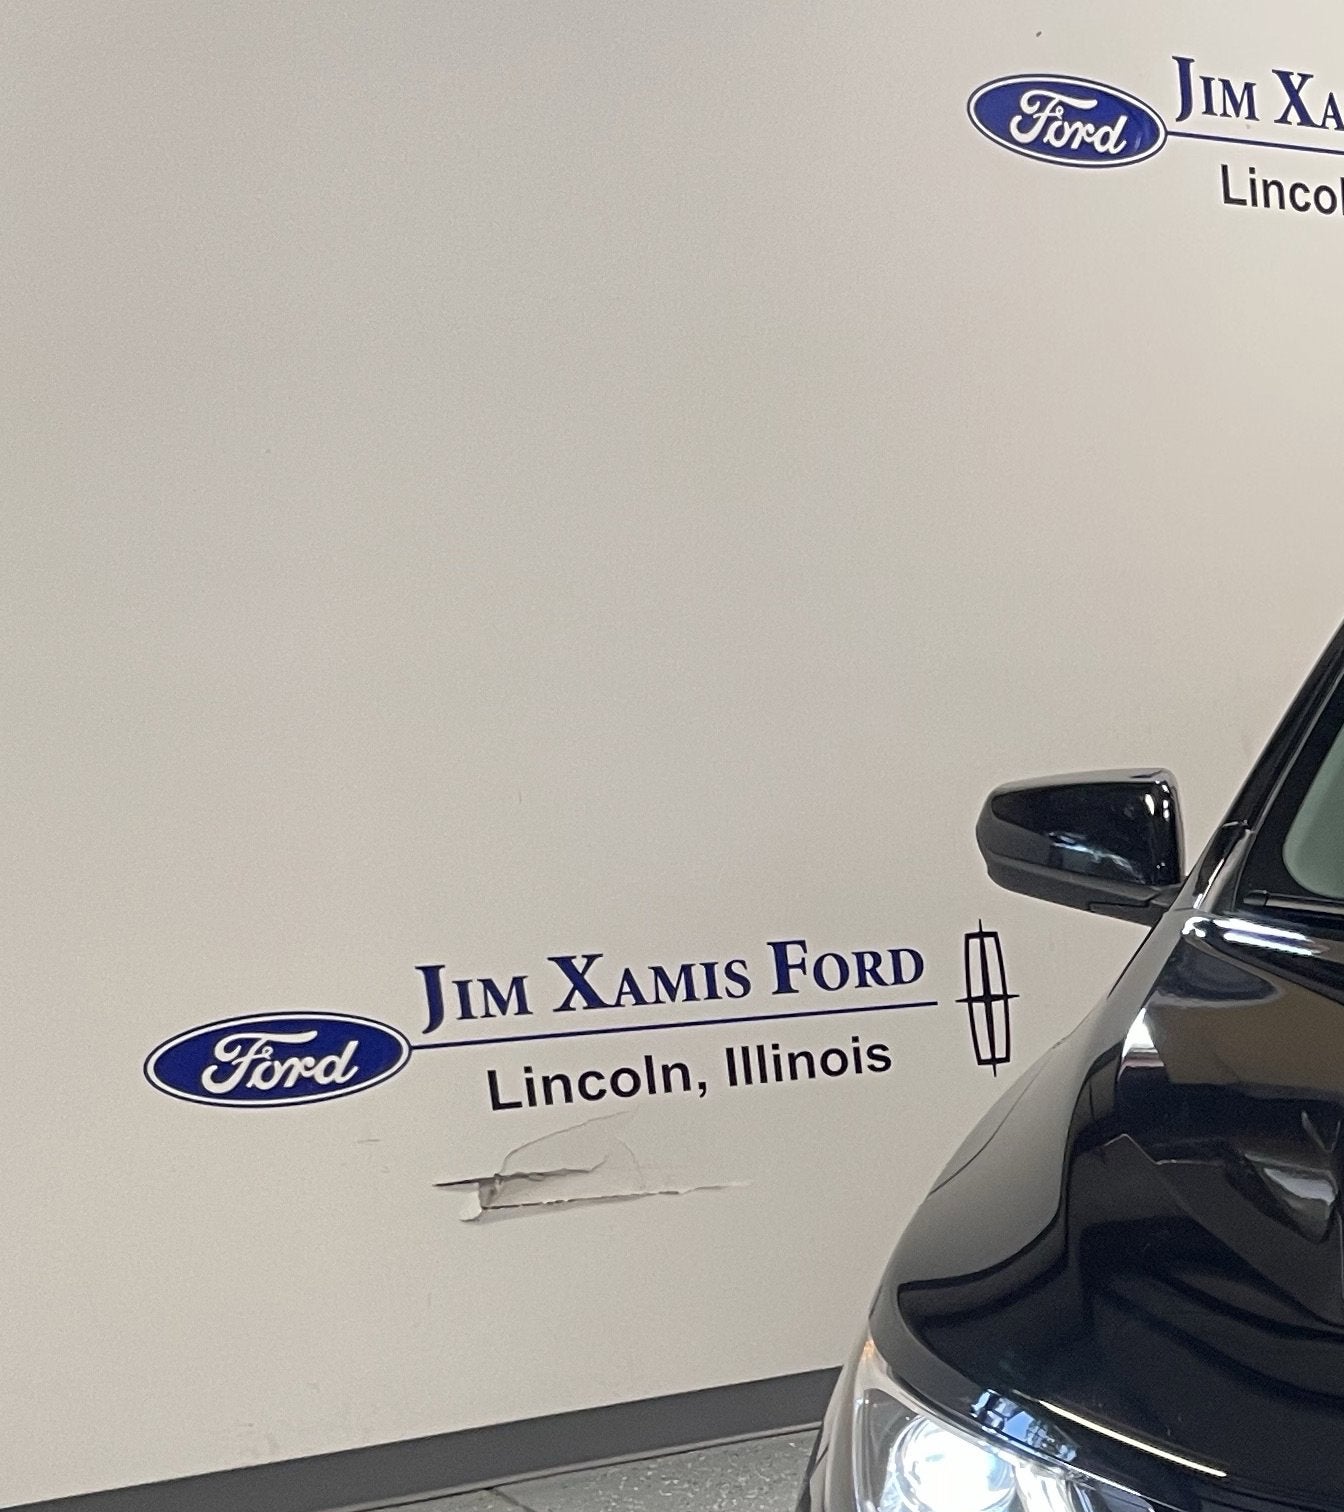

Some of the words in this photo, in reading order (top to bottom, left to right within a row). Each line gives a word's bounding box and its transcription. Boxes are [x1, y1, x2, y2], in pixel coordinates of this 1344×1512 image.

[1011, 89, 1127, 156] Ford
[200, 1031, 357, 1094] Ford
[486, 1050, 707, 1111] Lincoln,
[725, 1036, 893, 1087] Illinois
